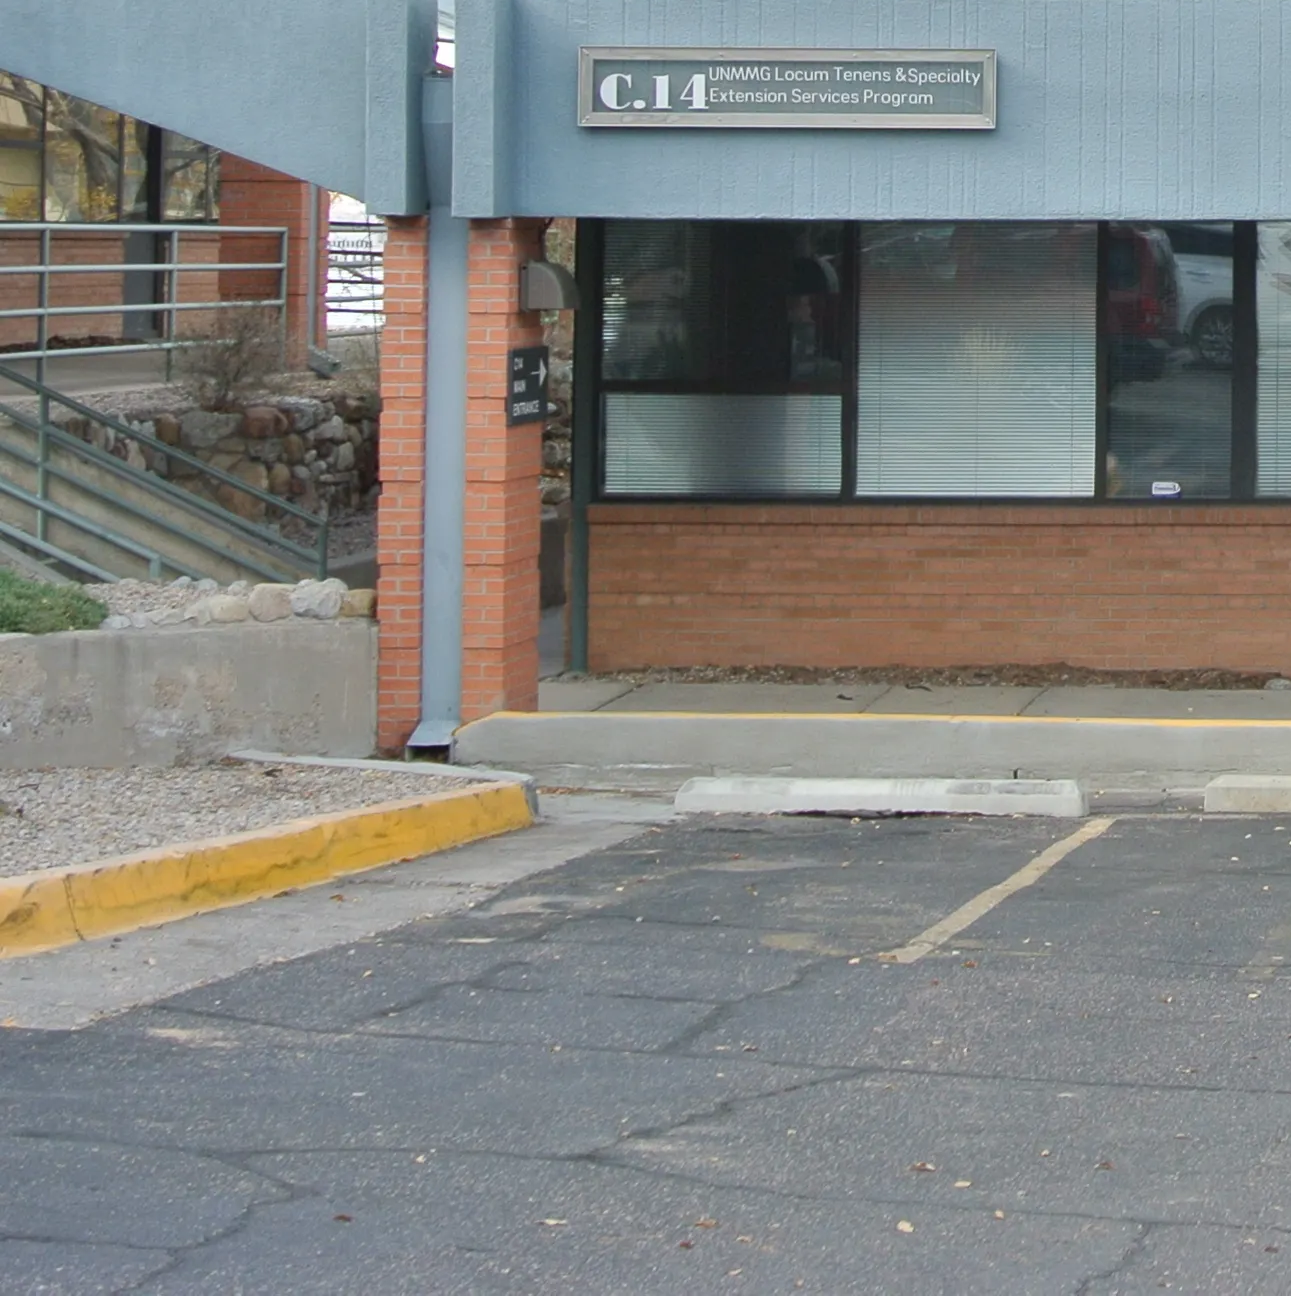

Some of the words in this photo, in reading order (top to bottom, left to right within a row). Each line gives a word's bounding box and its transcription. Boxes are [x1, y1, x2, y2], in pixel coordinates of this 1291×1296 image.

[708, 66, 771, 82] UNMMG
[774, 67, 829, 82] Locum
[834, 67, 891, 83] Tenens
[599, 73, 709, 110] C.14
[709, 88, 788, 103] Extension
[791, 89, 859, 104] Services
[863, 89, 933, 107] Program
[512, 399, 540, 417] ENTRANCE
